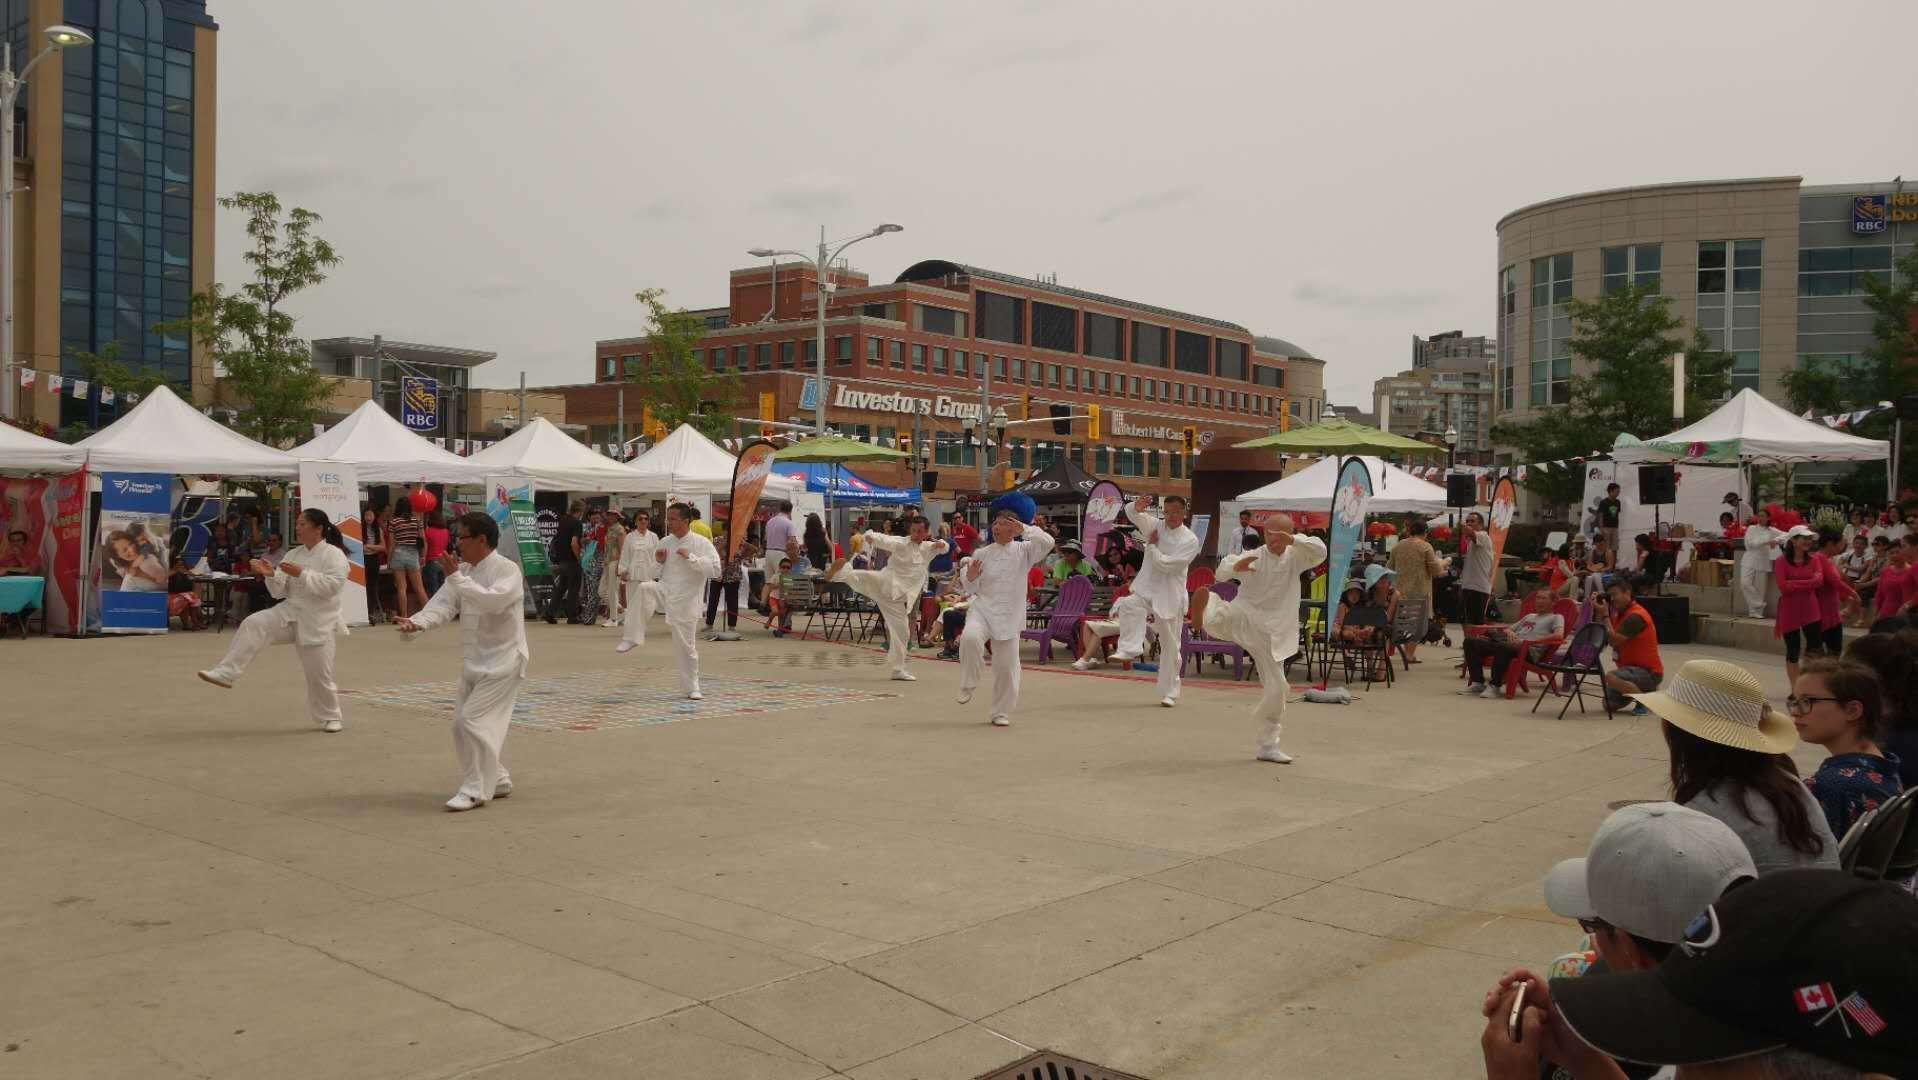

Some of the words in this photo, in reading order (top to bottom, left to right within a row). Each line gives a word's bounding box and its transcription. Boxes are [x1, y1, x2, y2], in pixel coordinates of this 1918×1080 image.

[1856, 221, 1883, 231] RBC
[833, 383, 931, 416] Investors
[935, 395, 991, 423] Group
[406, 414, 434, 426] RBC
